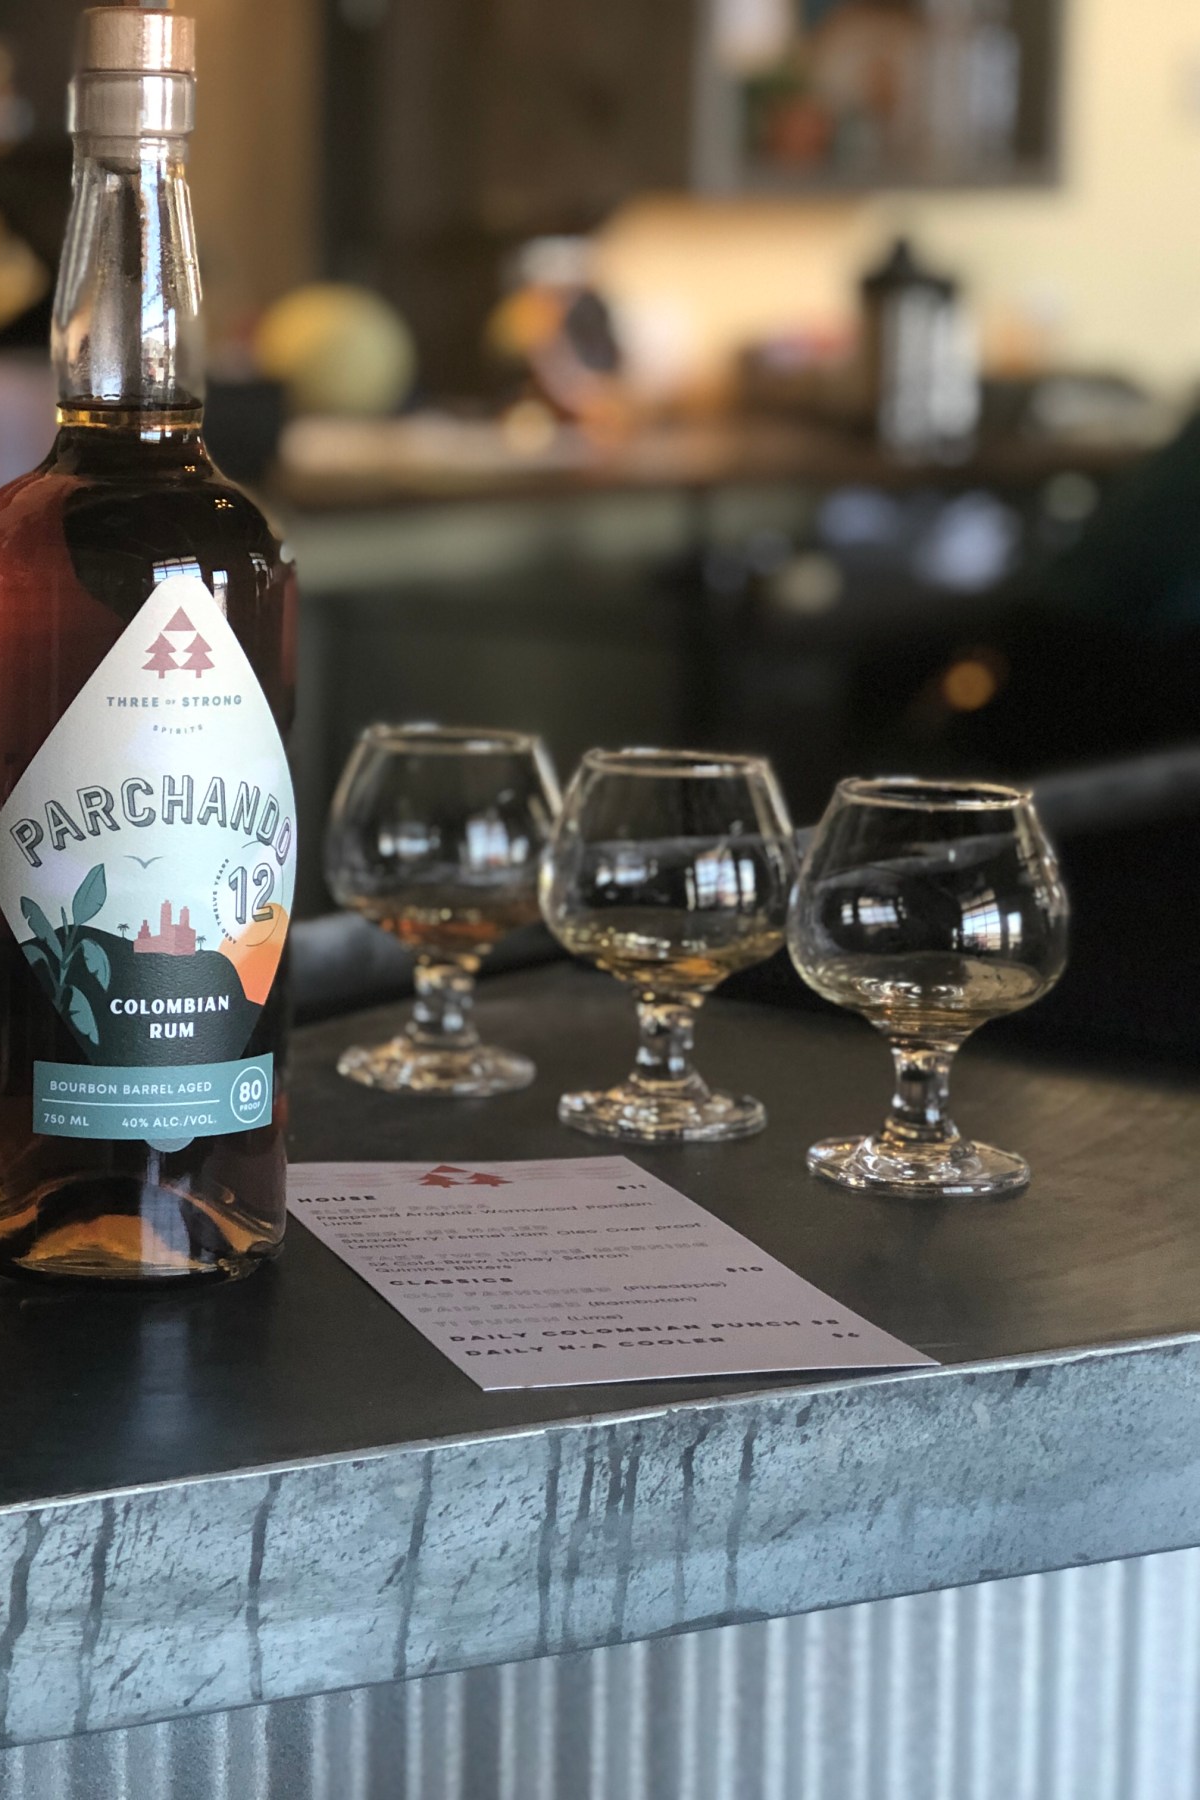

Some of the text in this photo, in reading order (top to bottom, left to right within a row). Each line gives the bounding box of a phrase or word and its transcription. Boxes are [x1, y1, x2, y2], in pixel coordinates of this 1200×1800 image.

[106, 696, 159, 708] THREE
[181, 694, 242, 707] STRONG
[152, 724, 204, 735] SPIRITS
[9, 775, 292, 868] PARCHANDO
[214, 858, 230, 886] YEARS
[228, 862, 275, 925] 12
[212, 891, 222, 927] TWELVE
[110, 995, 230, 1015] COLOMBIAN
[149, 1022, 194, 1039] RUM
[50, 1080, 212, 1094] BOURBON BARREL AGED
[239, 1079, 262, 1103] 80
[239, 1102, 261, 1112] PROOF
[43, 1113, 64, 1125] 750
[70, 1115, 90, 1127] ML
[122, 1118, 149, 1128] 40%
[298, 1195, 377, 1203] HOUSE
[316, 1212, 400, 1220] Peppered
[448, 1232, 505, 1240] Fennel
[390, 1278, 513, 1286] CLASSICS
[623, 1281, 728, 1291] (Pineapple)
[588, 1297, 697, 1306] (Rambutan)
[450, 1332, 526, 1342] DAILY
[542, 1324, 700, 1337] COLOMBIAN
[712, 1320, 800, 1329] PUNCH
[465, 1346, 543, 1356] DAILY
[558, 1342, 607, 1351] N-A
[618, 1336, 725, 1347] COOLER
